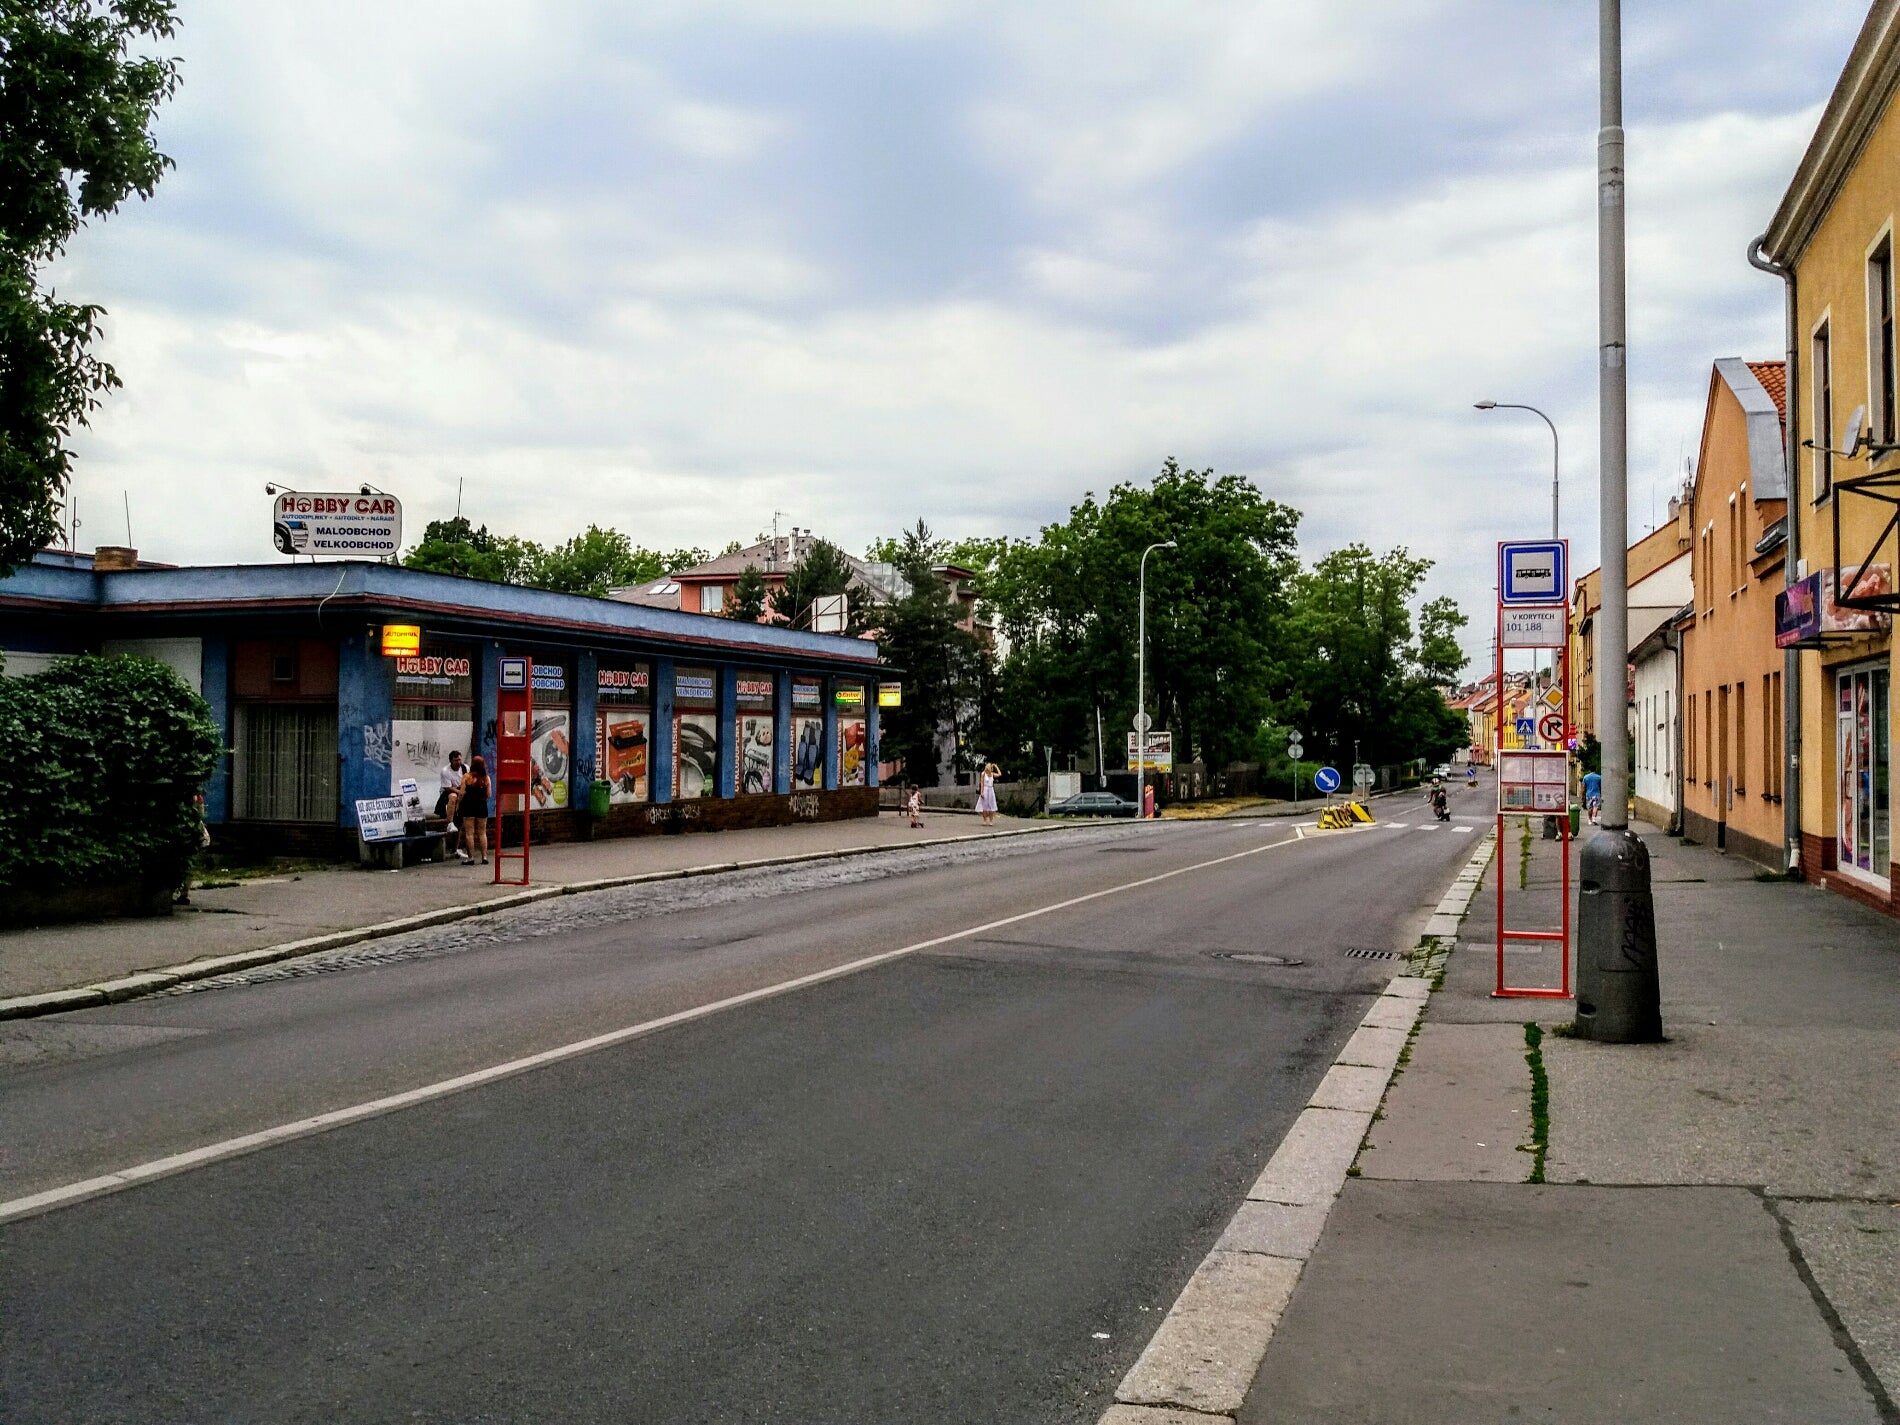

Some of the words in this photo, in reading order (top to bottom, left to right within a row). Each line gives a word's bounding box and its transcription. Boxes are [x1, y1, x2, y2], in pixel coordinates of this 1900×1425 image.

[281, 497, 350, 514] HOBBY
[354, 498, 396, 515] CAR
[316, 527, 391, 536] MALOOBCHOD
[313, 540, 394, 549] VELKOOBCHOD
[1506, 623, 1521, 631] 101
[1525, 622, 1542, 631] 188
[397, 657, 442, 675] HOBBY
[444, 658, 470, 676] CAR
[630, 671, 648, 687] CAR
